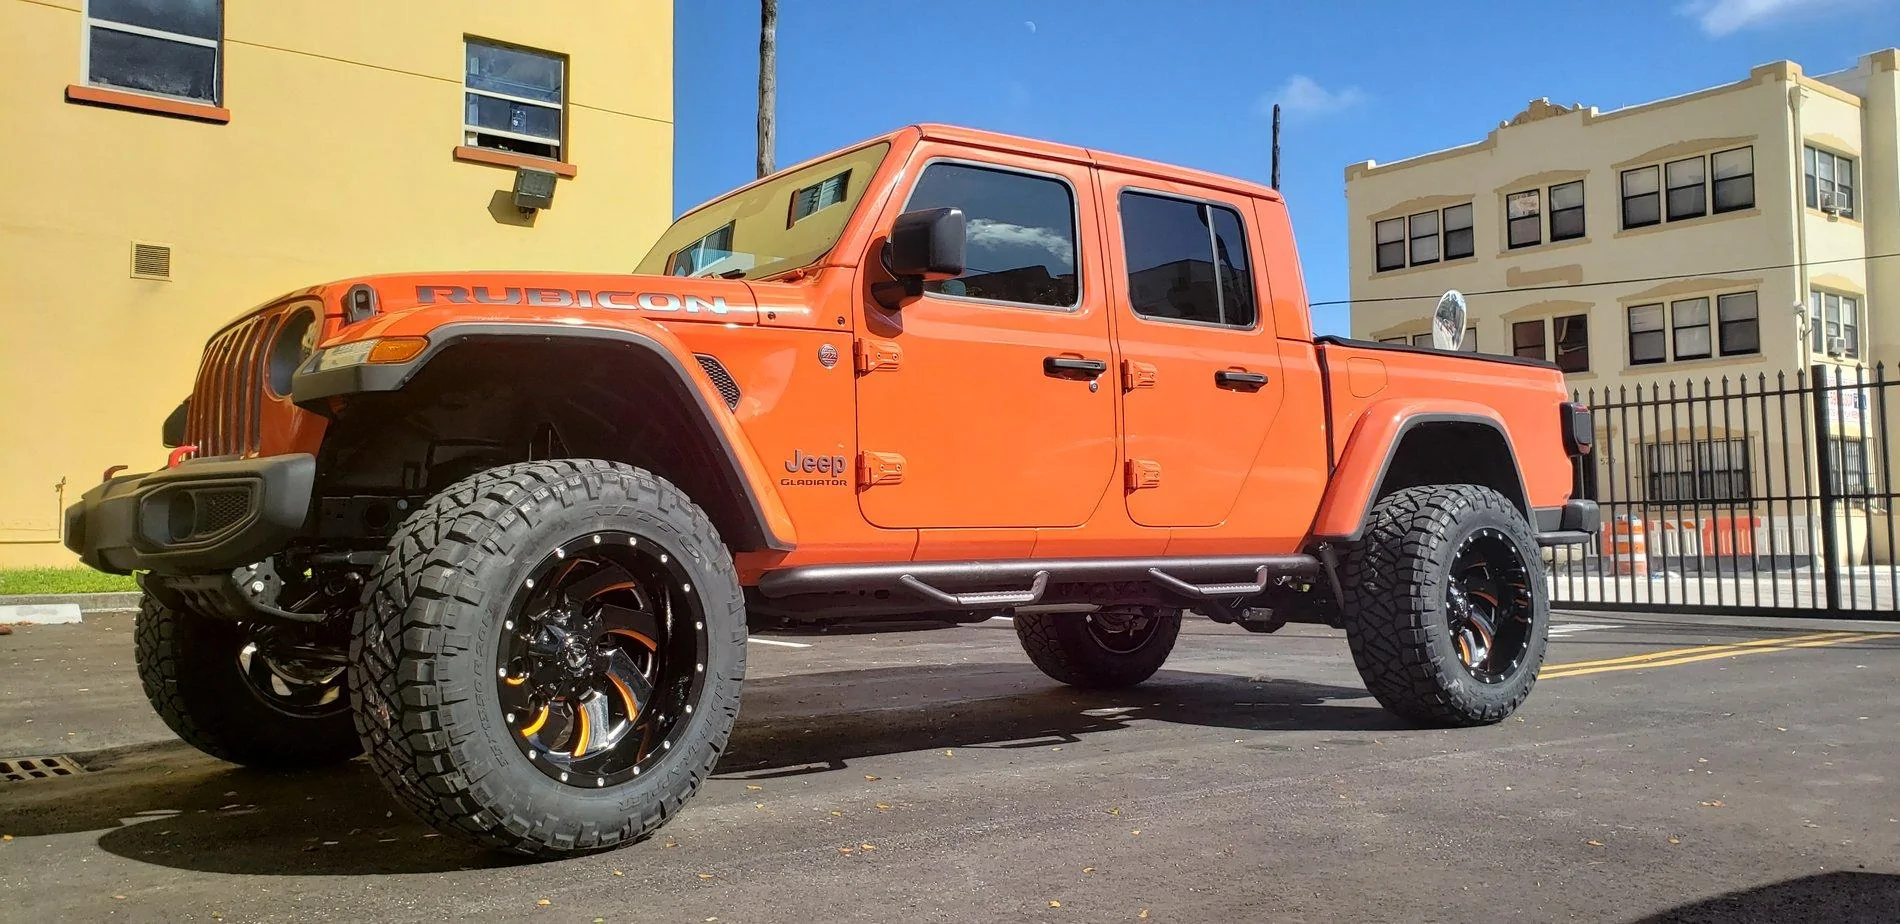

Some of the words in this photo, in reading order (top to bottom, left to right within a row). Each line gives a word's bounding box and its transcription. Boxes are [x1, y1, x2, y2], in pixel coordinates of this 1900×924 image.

[415, 285, 730, 314] RUBICON
[784, 449, 847, 477] Jeep
[780, 478, 848, 487] GLADIATOR
